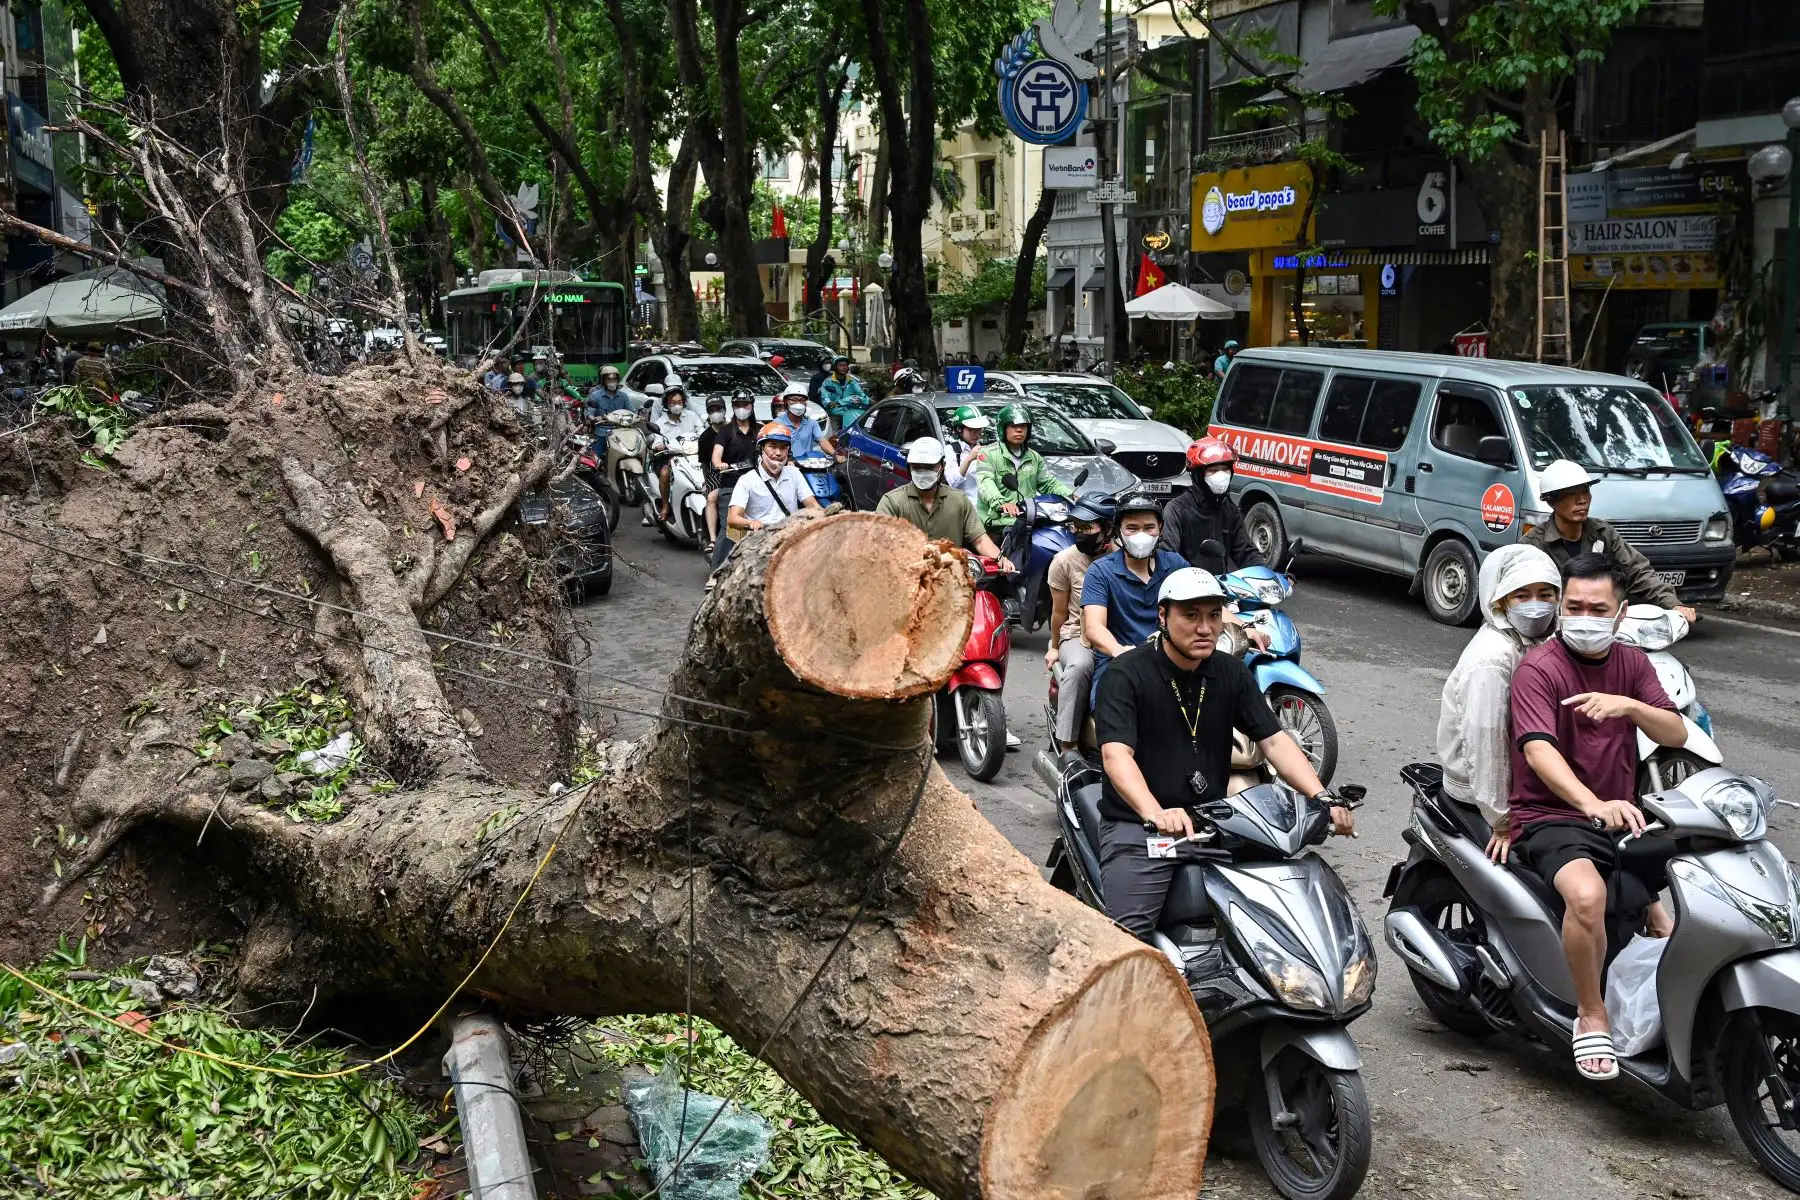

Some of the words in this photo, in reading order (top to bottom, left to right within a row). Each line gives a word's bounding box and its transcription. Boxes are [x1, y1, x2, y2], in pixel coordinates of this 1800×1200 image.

[1049, 163, 1086, 172] VietinBank
[1226, 191, 1255, 210] beard
[1258, 188, 1293, 211] papa's
[1418, 224, 1446, 235] COFFEE
[1584, 223, 1622, 241] HAIR
[1624, 219, 1677, 239] SALON
[1274, 256, 1285, 269] SU
[957, 369, 977, 390] G7
[1483, 503, 1513, 514] LALAMOVE
